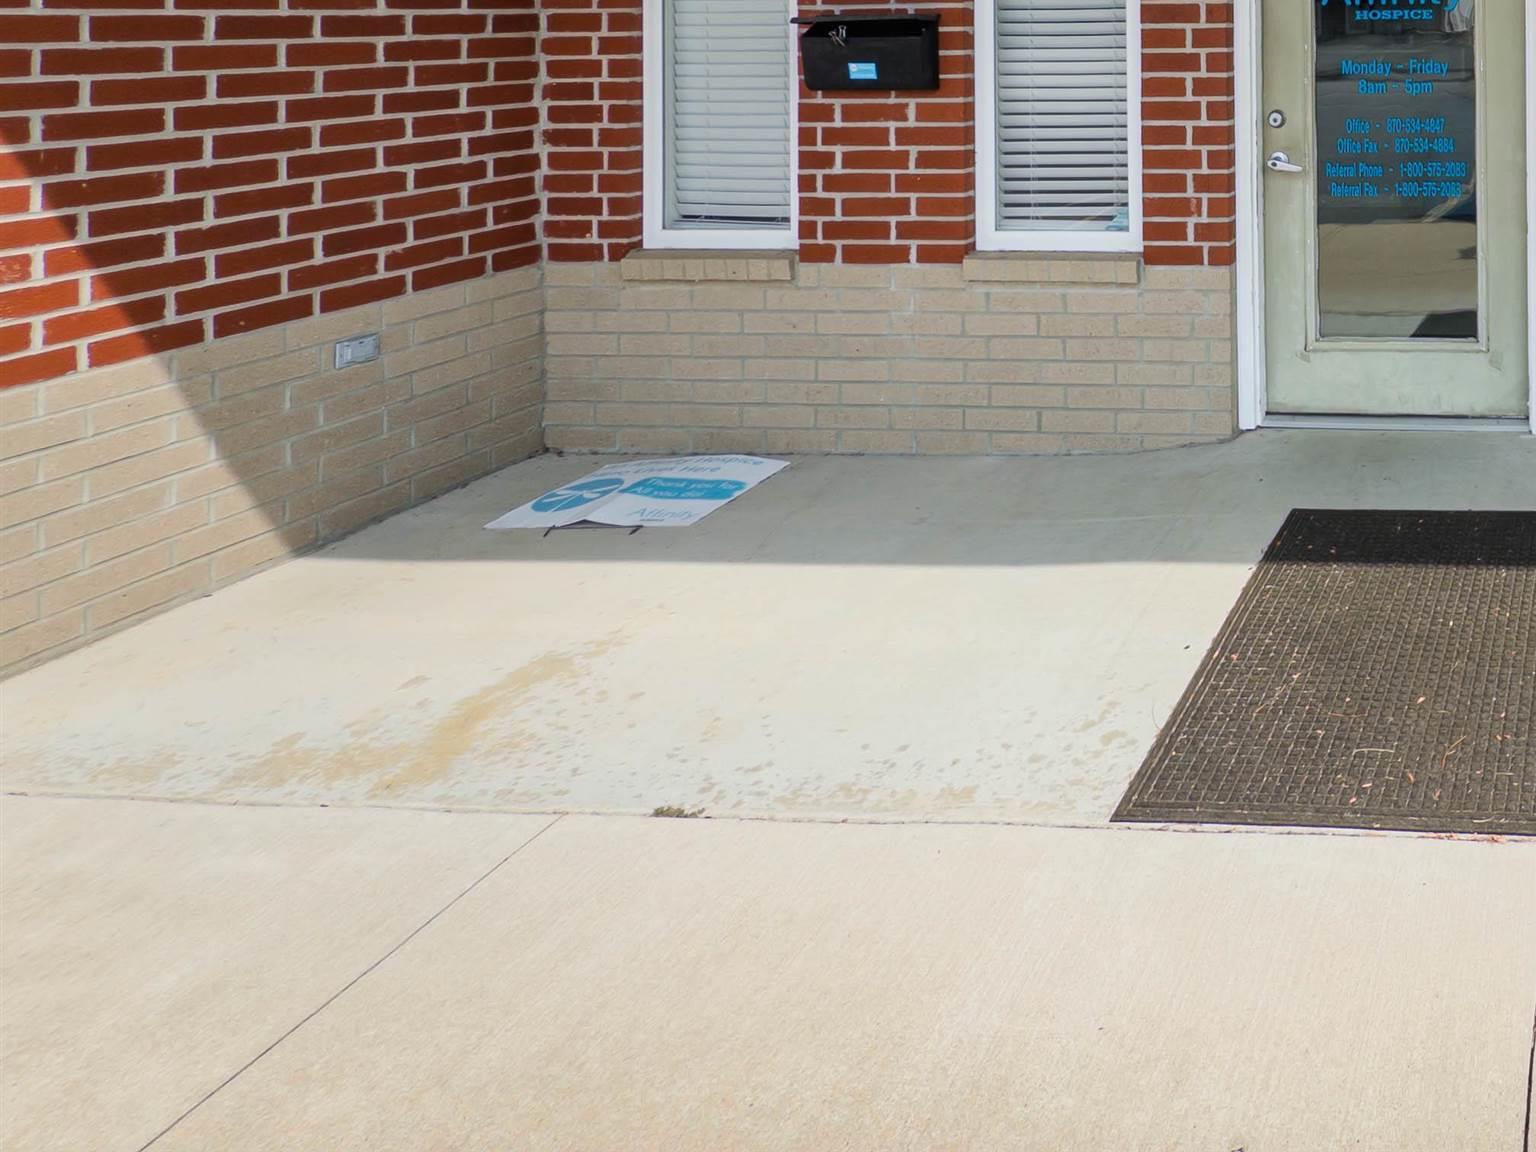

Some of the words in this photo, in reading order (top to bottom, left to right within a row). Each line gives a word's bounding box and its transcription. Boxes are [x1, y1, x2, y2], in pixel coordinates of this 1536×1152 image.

[1354, 9, 1433, 21] HOSPICE
[1341, 59, 1392, 77] Monday
[1409, 58, 1449, 77] Friday
[1359, 79, 1387, 94] 8am
[1404, 79, 1433, 96] 5pm
[1345, 118, 1370, 134] Office
[1337, 138, 1361, 153] Office
[1364, 138, 1378, 153] Fax
[1326, 162, 1357, 177] Referral
[1359, 162, 1383, 177] Phone
[1331, 182, 1361, 197] Referral
[1364, 182, 1378, 197] Fax
